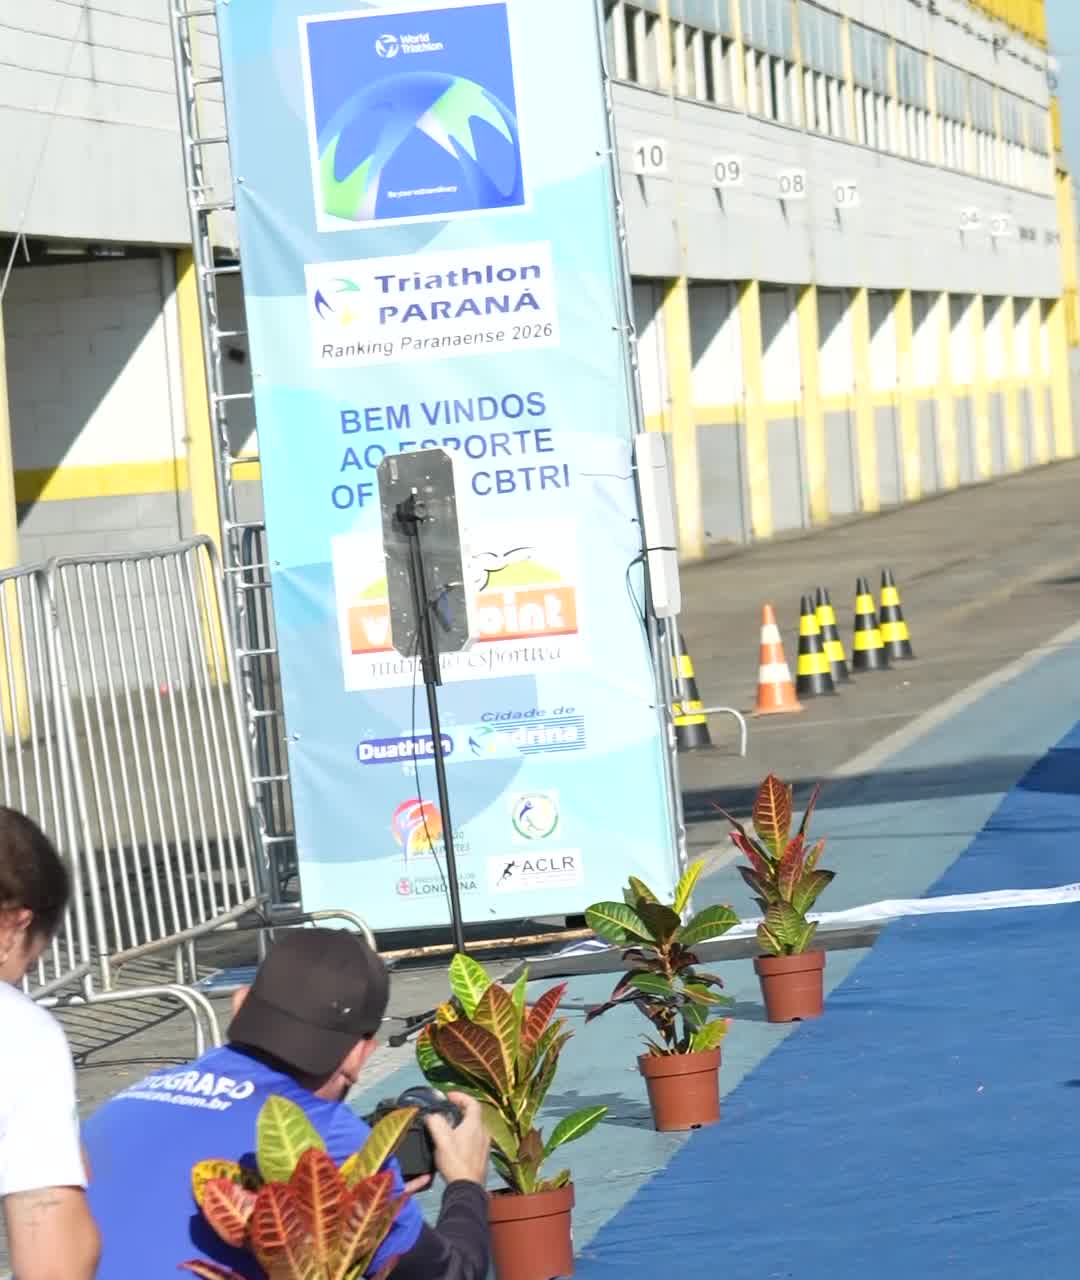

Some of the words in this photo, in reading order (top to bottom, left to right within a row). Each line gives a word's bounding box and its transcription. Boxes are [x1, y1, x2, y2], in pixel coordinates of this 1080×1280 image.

[636, 145, 663, 169] 10
[714, 161, 740, 183] 09
[779, 175, 804, 194] 08
[834, 186, 857, 203] 07
[374, 265, 542, 294] Triathlon
[379, 289, 541, 325] PARANÁ
[321, 340, 394, 359] Ranking
[400, 330, 506, 351] Paranaense
[511, 322, 553, 340] 2026
[340, 403, 411, 435] BEM
[420, 391, 546, 426] VINDOS
[471, 463, 570, 496] CBTRI
[481, 707, 548, 723] Cidade
[552, 705, 576, 716] de
[522, 855, 576, 873] ACLR
